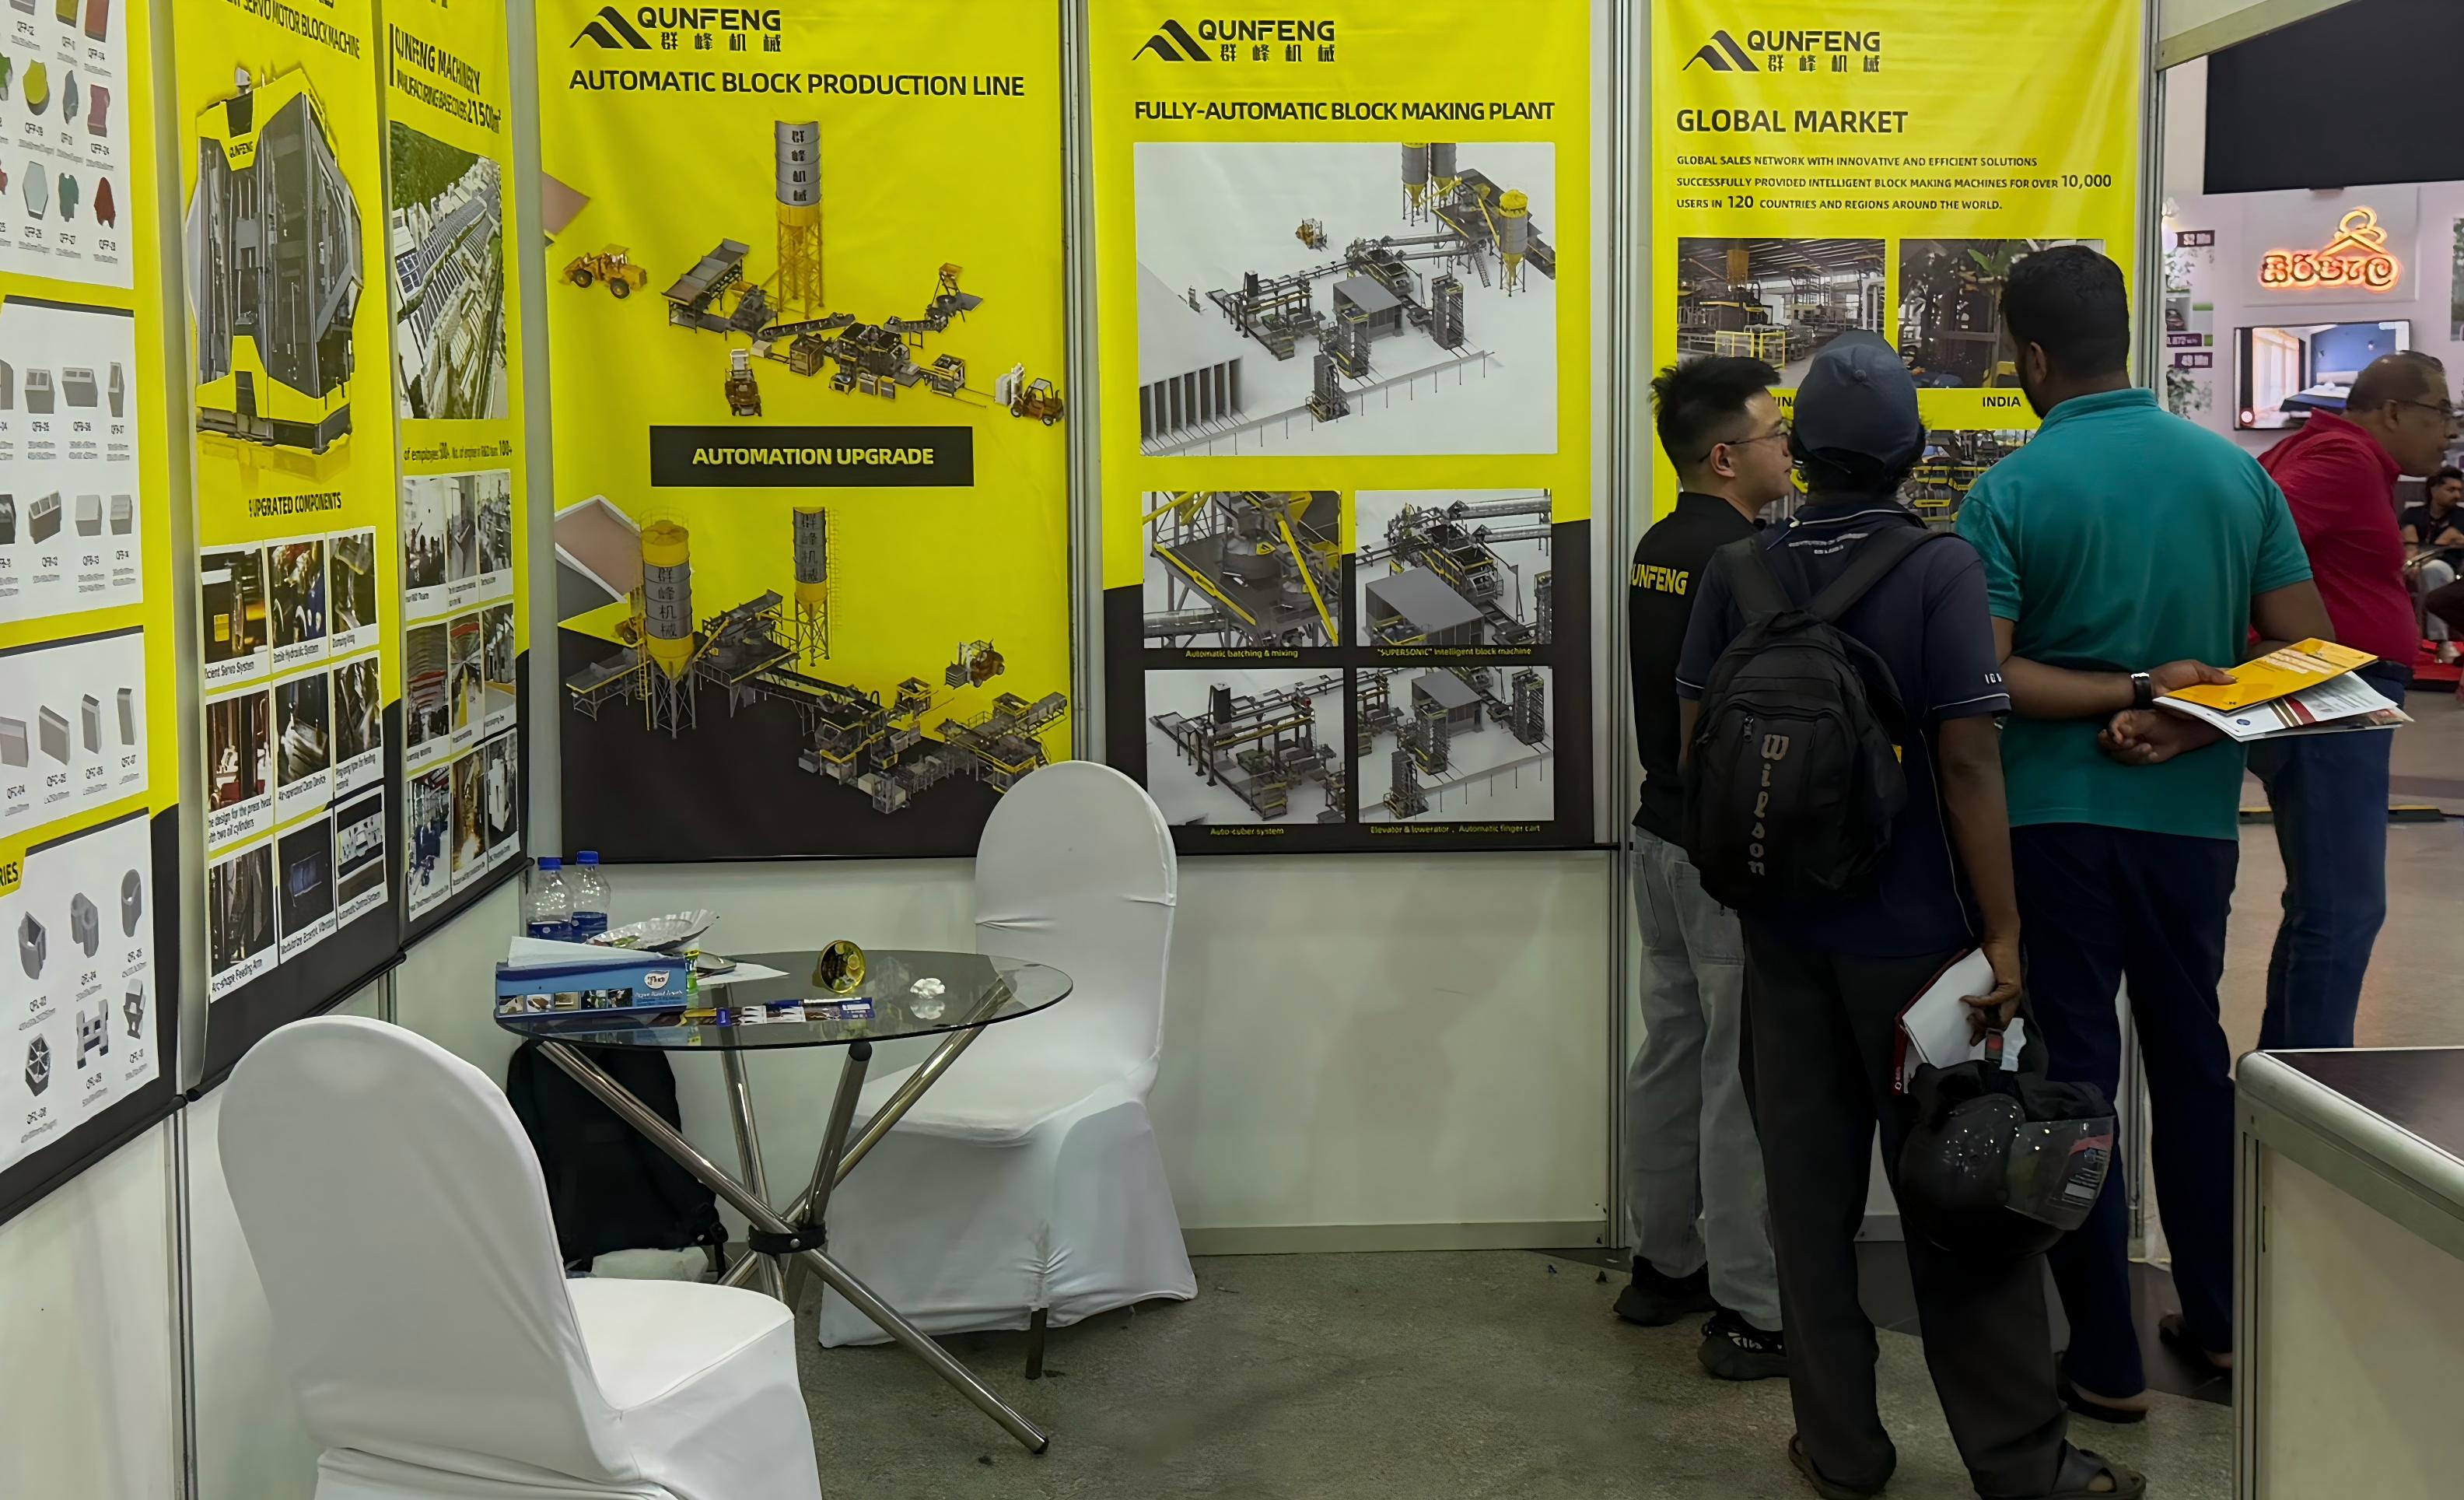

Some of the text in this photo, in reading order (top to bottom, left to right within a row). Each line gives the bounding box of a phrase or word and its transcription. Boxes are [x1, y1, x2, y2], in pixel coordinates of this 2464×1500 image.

[271, 0, 301, 34] MOTOR
[637, 8, 782, 31] QUNFENG
[1198, 19, 1335, 42] QUNFENG
[660, 31, 782, 53] 群峰机械
[1747, 30, 1881, 52] QUNFENG
[1220, 43, 1335, 62] 群峰机械
[1767, 54, 1880, 73] 群峰机械
[569, 69, 1025, 96] AUTOMATIC BLOCK PRODUCTION LINE
[1135, 101, 1556, 121] FULLY-AUTOMATIC BLOCK MAKING PLANT
[1676, 109, 1909, 134] GLOBAL MARKET
[1677, 156, 2038, 167] GLOBAL SALES NETWORK WITH INNOVATIVE AND EFFICIENT SOLUTIONS
[1676, 173, 2112, 190] SUCCESSFULLY PROVIDED INTELLIGENT BLOCK MAKING MACHINES FOR OVER 10,000
[1676, 195, 2003, 210] USERS IN 120 COUNTRIES AND REGIONS AROUND THE WORLD.
[1982, 396, 2021, 408] INDIA
[692, 447, 934, 465] AUTOMATION UPGRADE
[1632, 563, 1689, 596] UNFENG
[1227, 650, 1262, 659] batching
[1272, 650, 1298, 658] mixing
[1377, 648, 1433, 657] "SUPERSONIC"
[1370, 825, 1402, 834] Elevator
[1459, 825, 1499, 833] Automatic
[1500, 825, 1524, 834] finger
